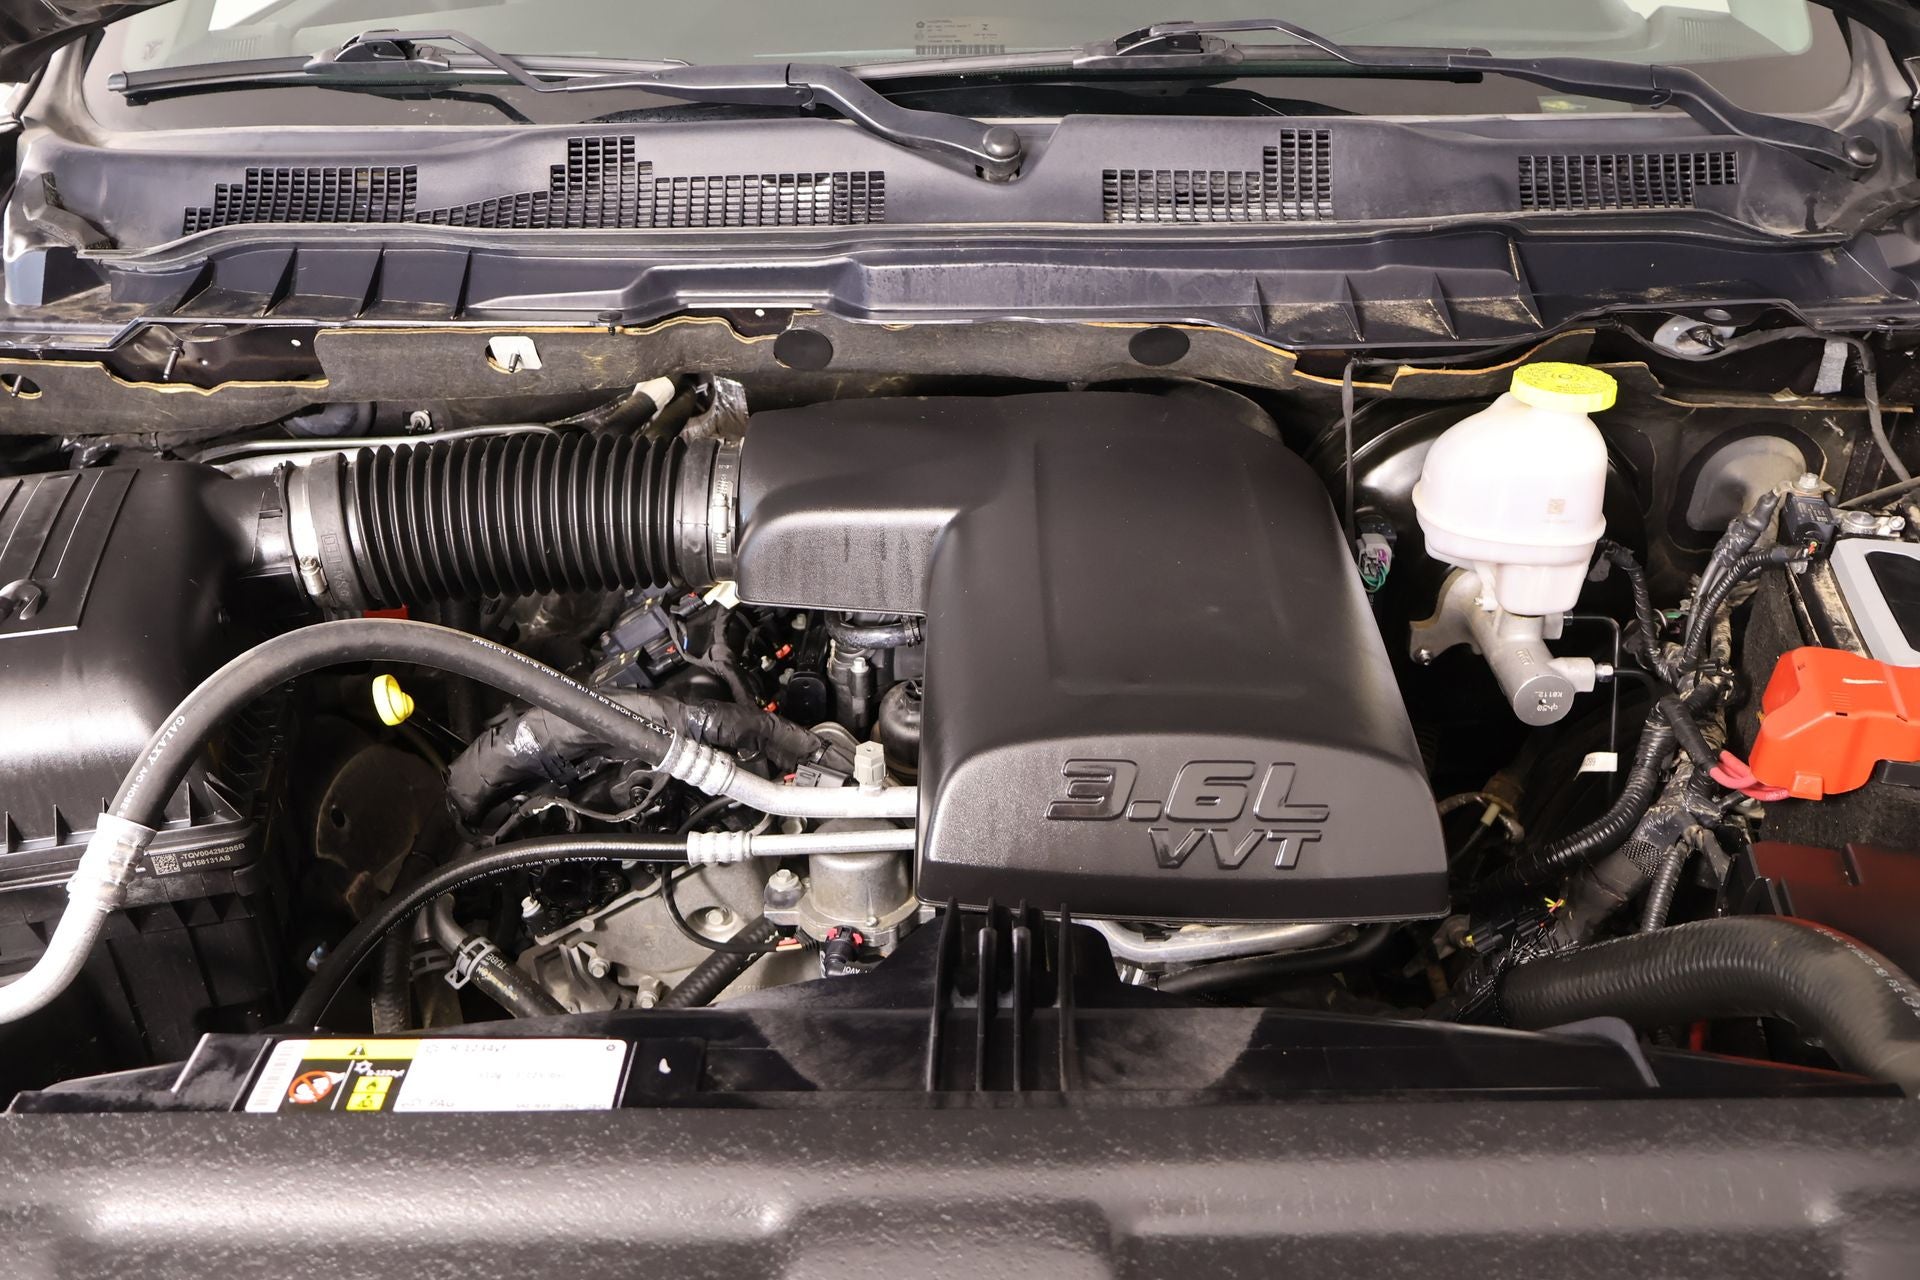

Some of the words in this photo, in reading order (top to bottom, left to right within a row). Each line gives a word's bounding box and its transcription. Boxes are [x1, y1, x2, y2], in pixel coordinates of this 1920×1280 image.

[589, 691, 598, 699] IN
[598, 695, 609, 705] 5/8
[610, 703, 631, 717] HOSE
[632, 714, 645, 723] A/C
[147, 715, 185, 767] GALAXY
[135, 766, 148, 783] A/C
[120, 783, 140, 811] HOSE
[1044, 757, 1330, 823] 3.6L
[1147, 827, 1322, 871] VVT
[485, 952, 507, 970] TUBE
